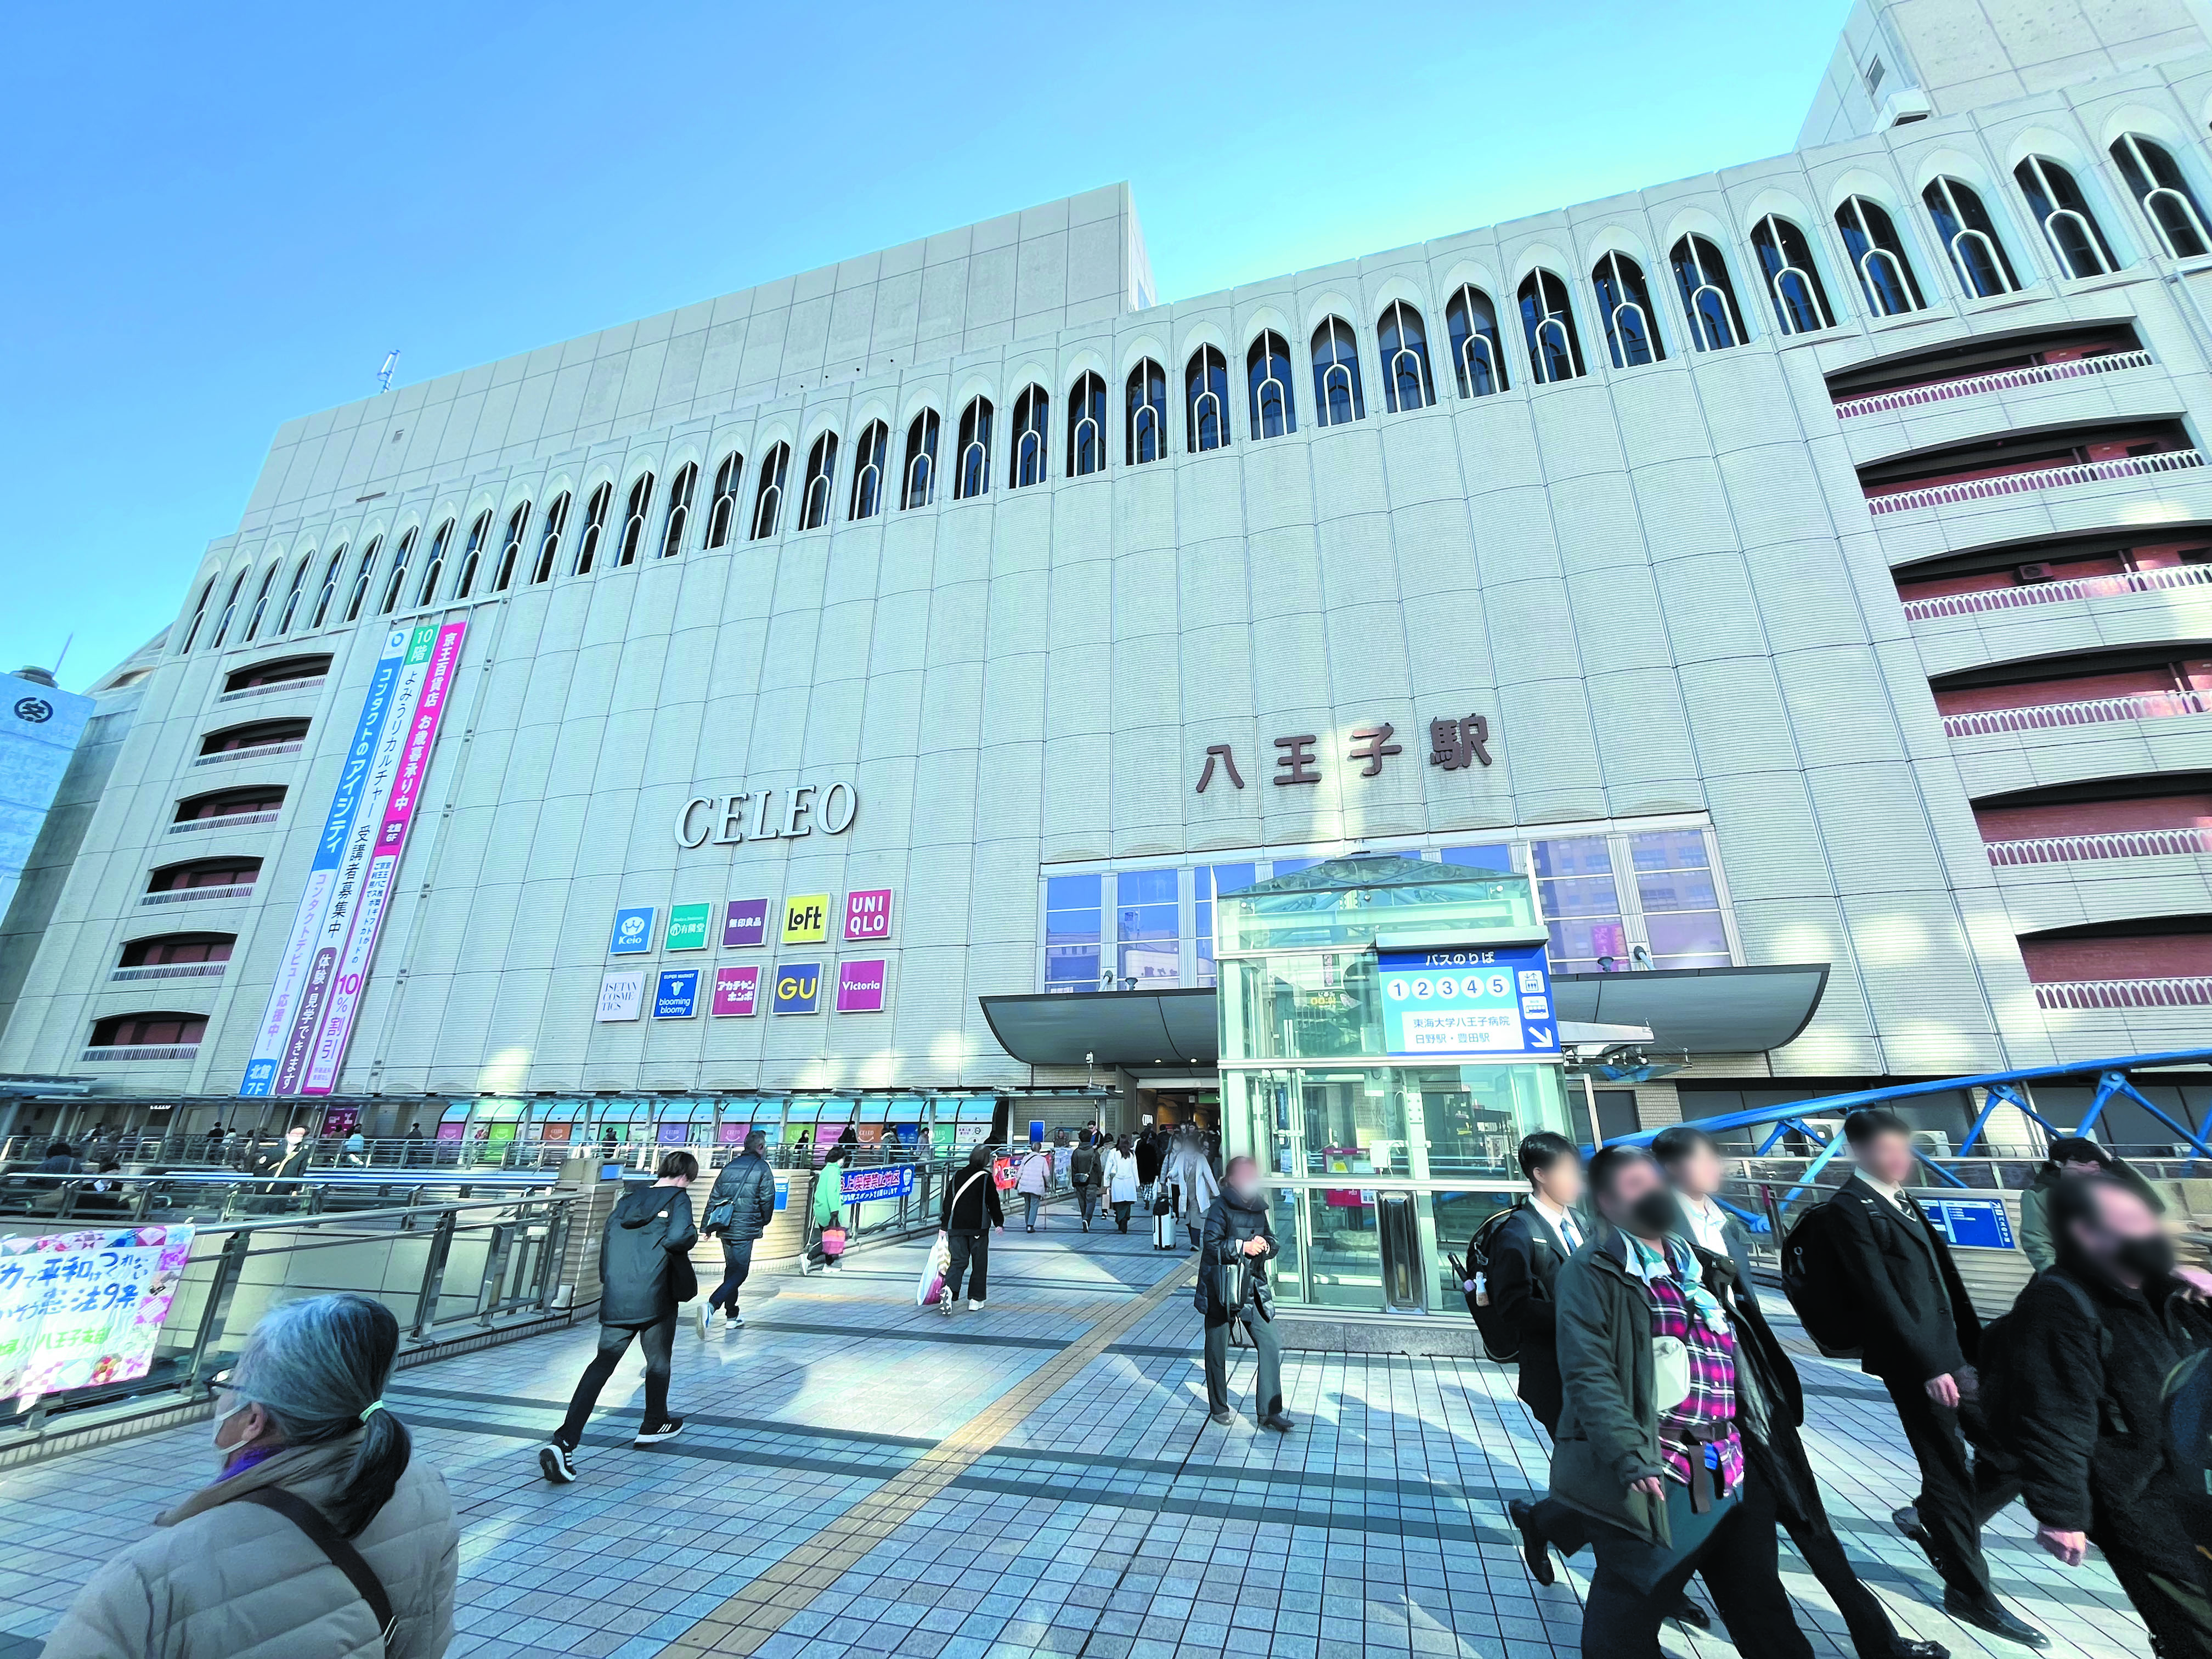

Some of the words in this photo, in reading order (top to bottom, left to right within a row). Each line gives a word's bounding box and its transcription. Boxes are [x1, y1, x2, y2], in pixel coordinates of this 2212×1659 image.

[424, 632, 458, 708] 京王百貨店
[367, 671, 417, 819] よみうりカルチャー
[1196, 713, 1492, 792] 八王子駅
[326, 668, 393, 854] コンタクトのアイシティ
[394, 714, 432, 812] お歳暮承り中
[674, 781, 856, 848] CELEO
[328, 825, 371, 939] 受講者募集中
[852, 896, 883, 912] UNI
[729, 916, 762, 929] 無印良品
[850, 915, 884, 935] QLO
[618, 935, 642, 945] Keio
[1425, 951, 1495, 967] バスのりば
[717, 980, 755, 991] アカチャン
[777, 977, 817, 1000] GU
[842, 980, 880, 991] Victoria
[659, 997, 691, 1006] blooming
[660, 1006, 686, 1015] bloomy
[283, 954, 331, 1090] 体験・見学できます
[1413, 1015, 1510, 1028] 東海大学八王子病院
[1415, 1032, 1490, 1045] 日野駅・豊田駅
[250, 1064, 272, 1079] 北館
[247, 1082, 266, 1094] 7F
